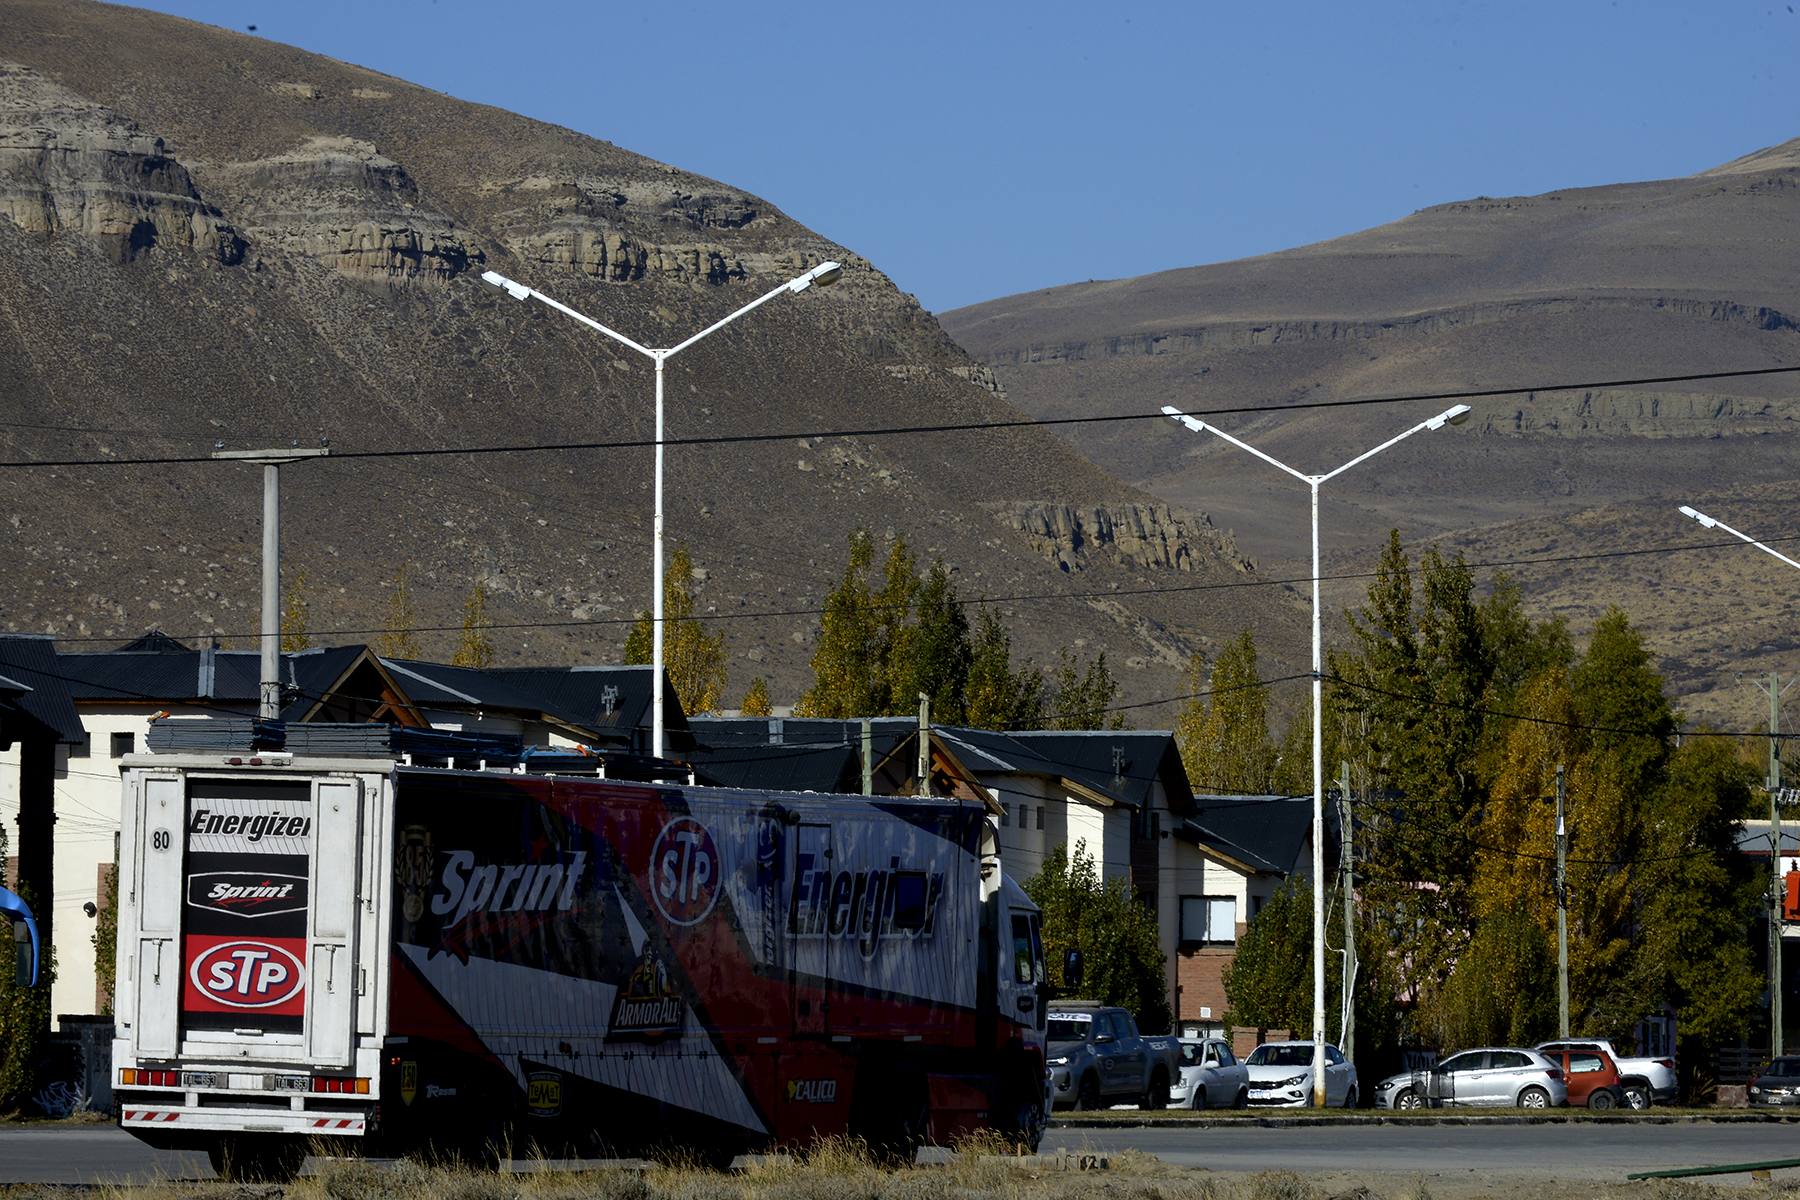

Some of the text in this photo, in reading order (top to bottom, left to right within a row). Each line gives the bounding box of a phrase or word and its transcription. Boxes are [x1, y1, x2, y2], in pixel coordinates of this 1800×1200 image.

[154, 831, 170, 849] 80
[191, 809, 311, 843] Energizer
[660, 831, 710, 903] STP
[208, 881, 294, 900] Sprint
[430, 850, 587, 930] Sprint
[208, 951, 288, 995] STP
